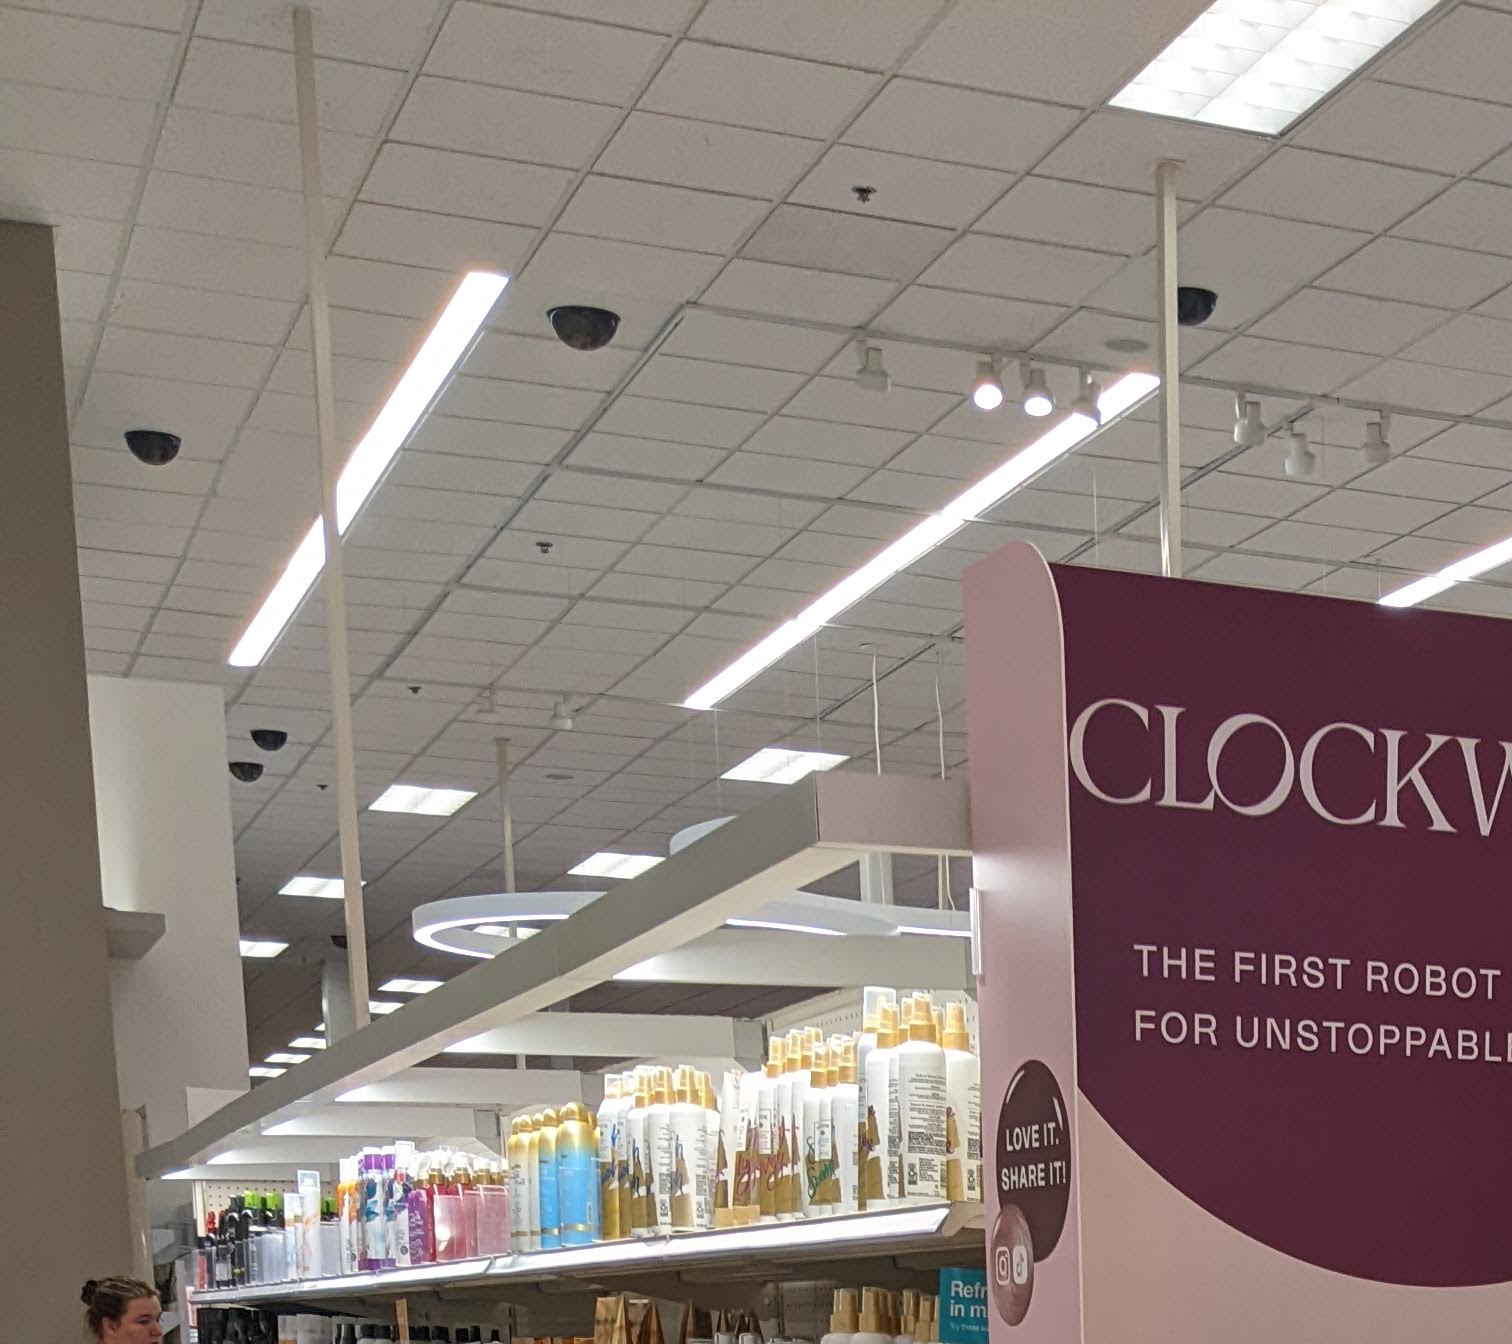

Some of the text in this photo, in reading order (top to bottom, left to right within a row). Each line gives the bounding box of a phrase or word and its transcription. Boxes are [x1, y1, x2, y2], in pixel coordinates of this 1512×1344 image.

[1133, 944, 1217, 982] THE
[1233, 951, 1351, 990] FIRST
[1366, 963, 1501, 1000] ROBOT
[1133, 1010, 1218, 1046] FOR
[1006, 1122, 1060, 1152] LOVE IT.
[1001, 1160, 1067, 1192] SHARE IT!
[950, 1300, 969, 1318] in
